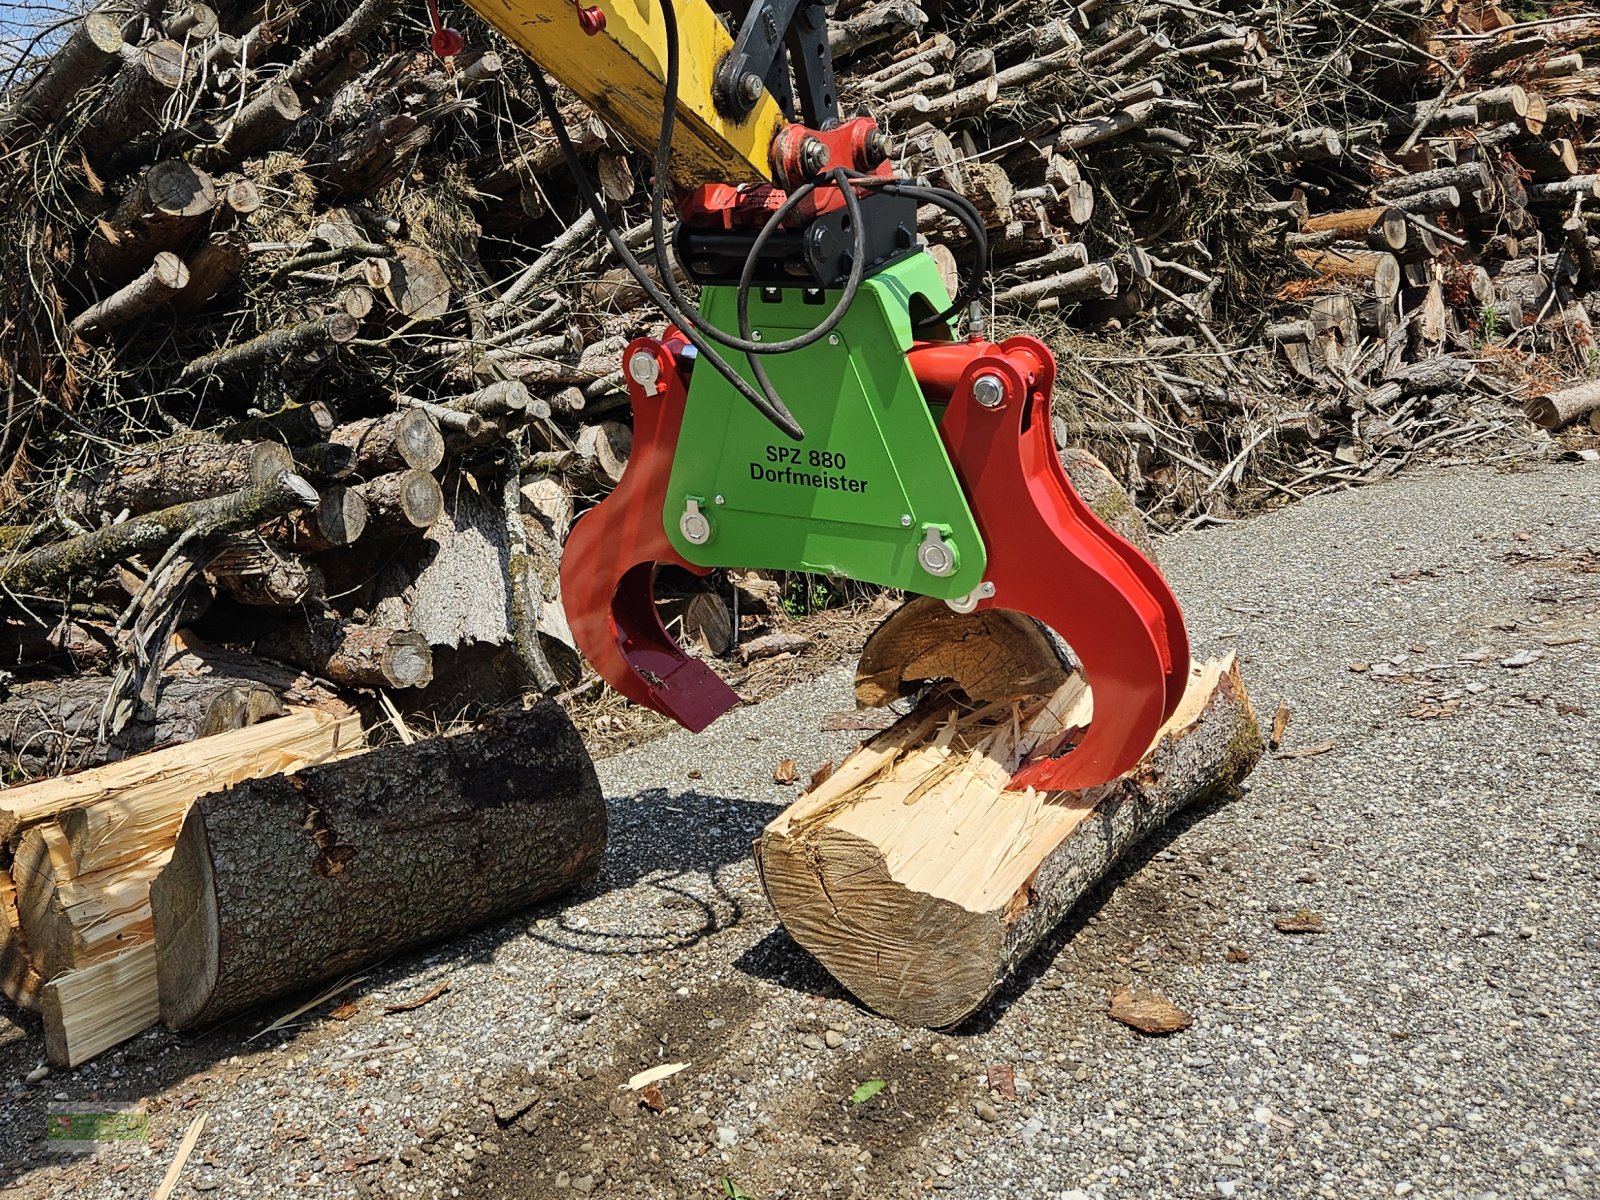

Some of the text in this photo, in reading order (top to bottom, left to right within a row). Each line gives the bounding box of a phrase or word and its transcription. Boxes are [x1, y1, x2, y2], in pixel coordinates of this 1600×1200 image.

[766, 445, 846, 470] SPZ 880
[750, 462, 868, 493] Dorfmeister
